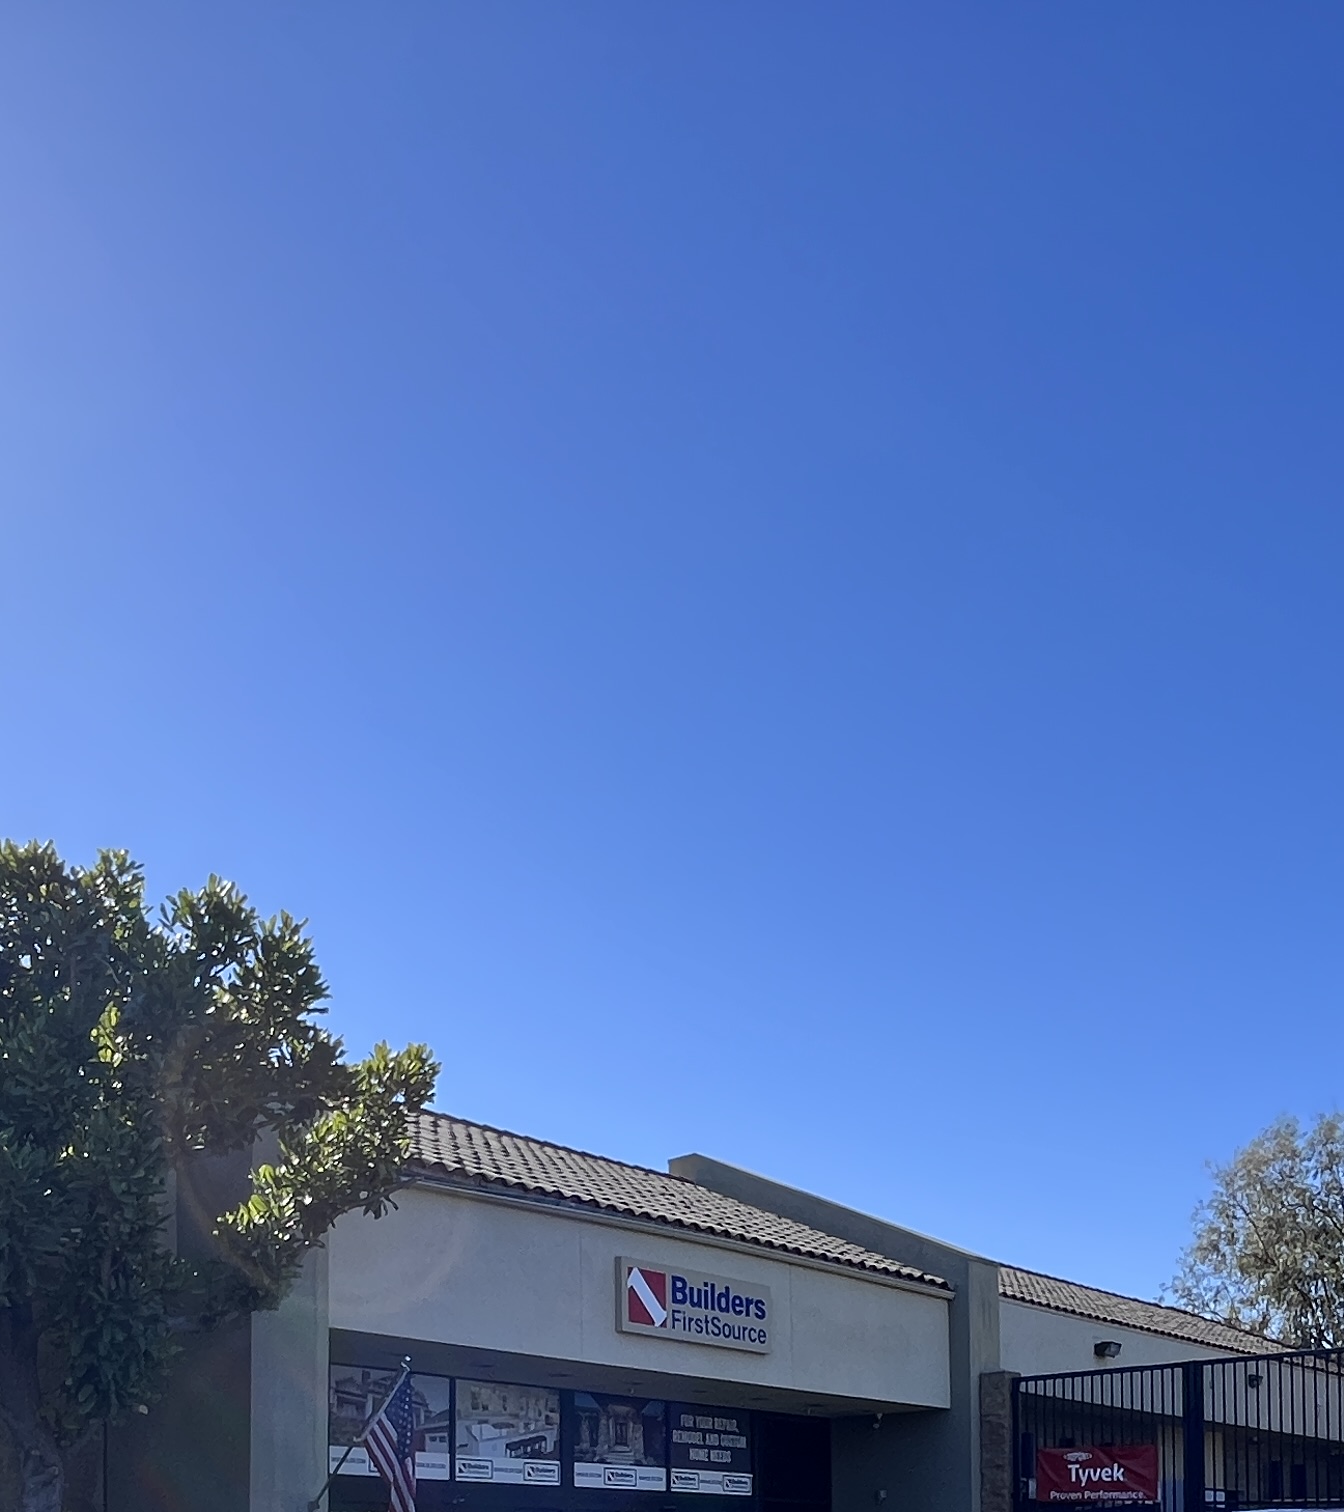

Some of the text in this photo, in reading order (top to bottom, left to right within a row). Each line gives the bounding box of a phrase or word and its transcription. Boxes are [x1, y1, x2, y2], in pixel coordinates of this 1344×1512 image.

[671, 1275, 766, 1320] Builders
[671, 1309, 767, 1344] FirstSource
[1067, 1463, 1125, 1487] Tyvek
[1050, 1490, 1147, 1500] Proven Performance.
